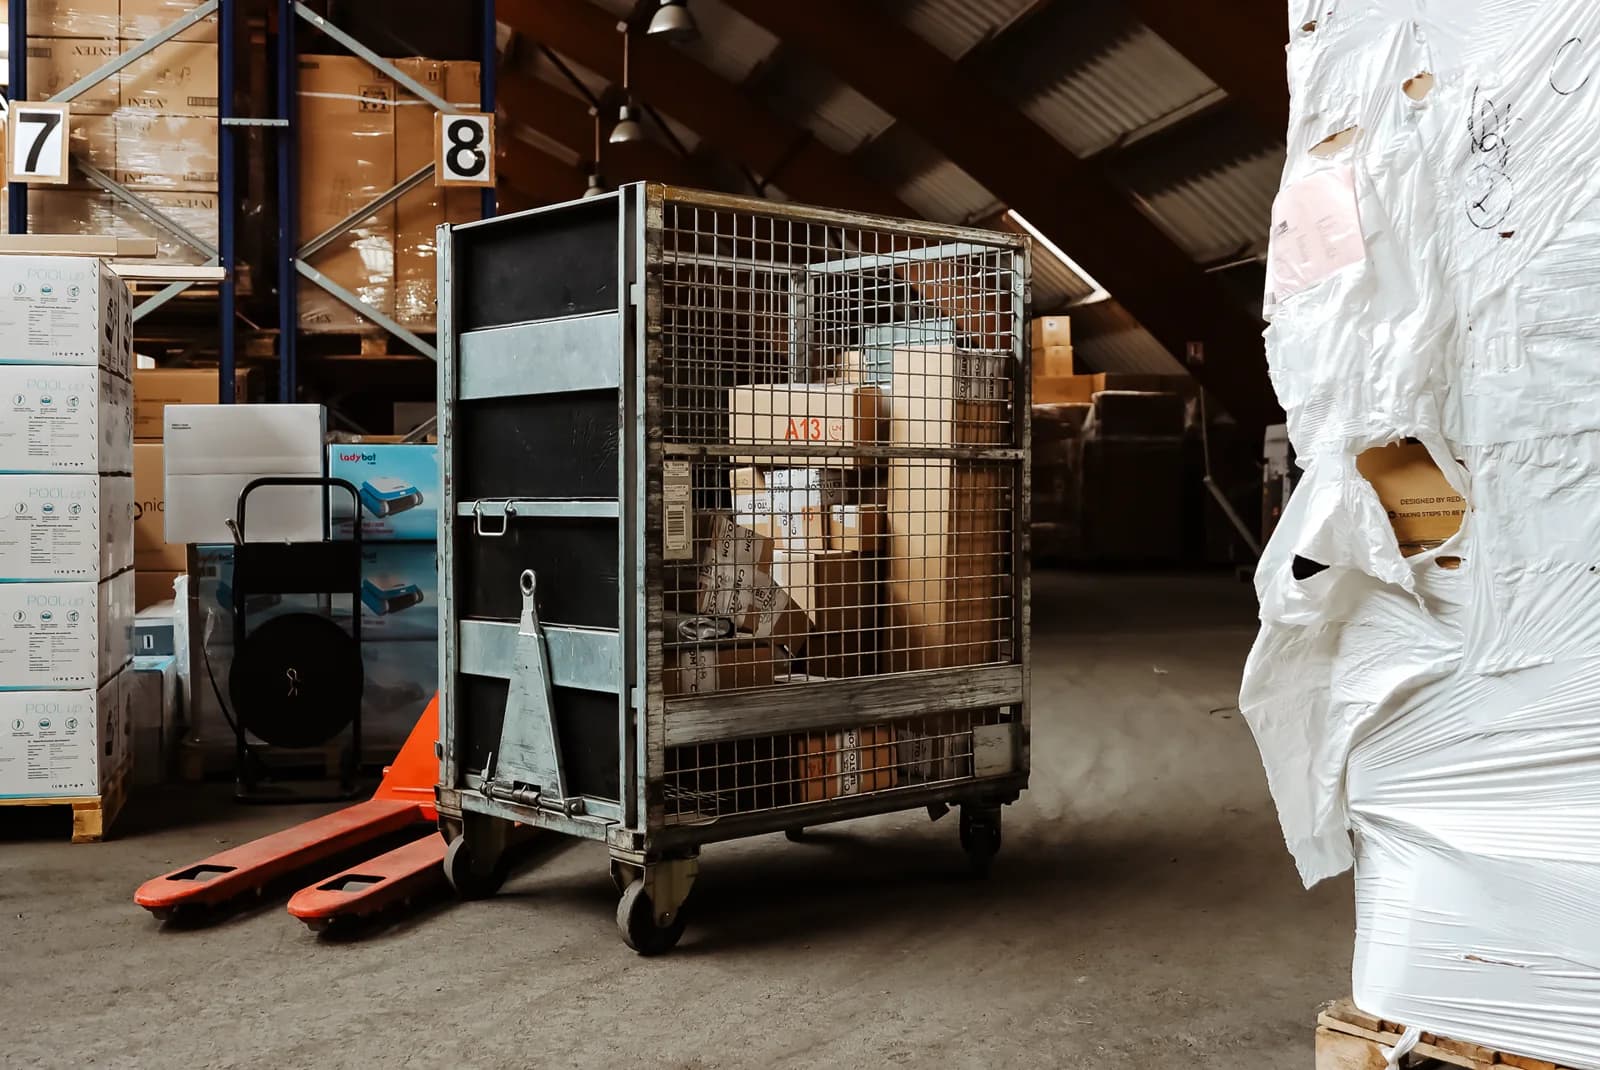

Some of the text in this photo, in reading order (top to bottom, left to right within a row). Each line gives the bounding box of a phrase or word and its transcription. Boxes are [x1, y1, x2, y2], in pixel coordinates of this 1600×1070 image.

[19, 112, 61, 172] 7
[446, 119, 486, 177] 8
[785, 418, 821, 441] A13
[1400, 496, 1434, 505] DESIGNED
[1436, 496, 1445, 504] BY
[25, 703, 63, 713] POOL
